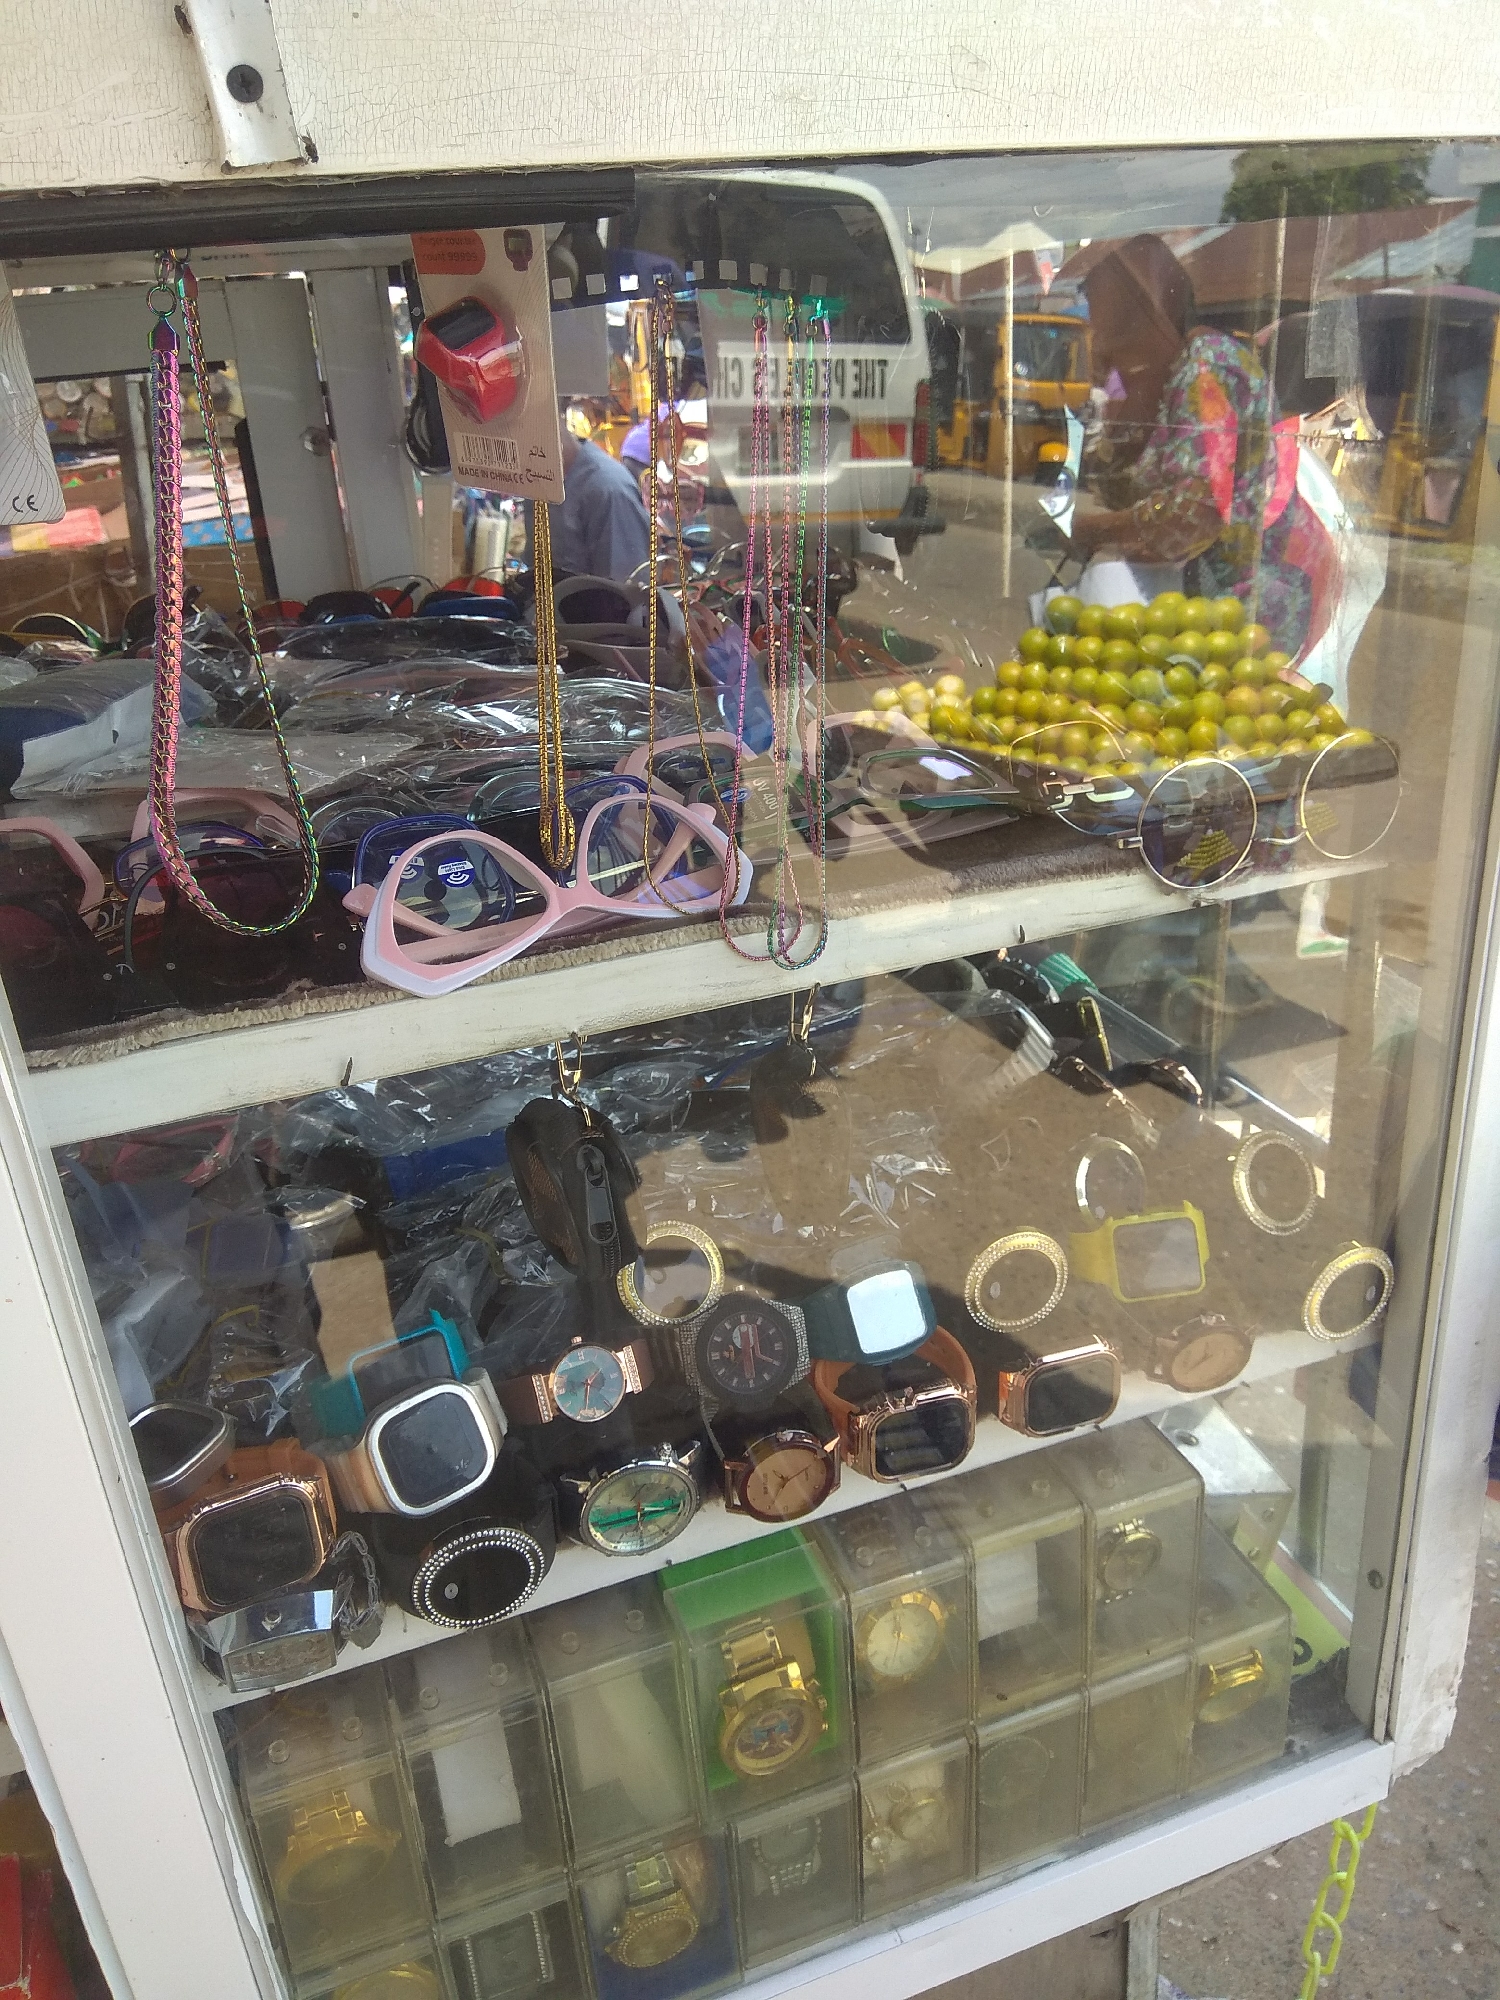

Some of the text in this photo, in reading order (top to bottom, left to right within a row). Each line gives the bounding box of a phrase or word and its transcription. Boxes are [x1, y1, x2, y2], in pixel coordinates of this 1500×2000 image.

[458, 466, 479, 478] MADE
[481, 469, 489, 479] IN
[490, 471, 513, 482] CHINA
[12, 494, 39, 513] CE
[752, 778, 770, 792] UV
